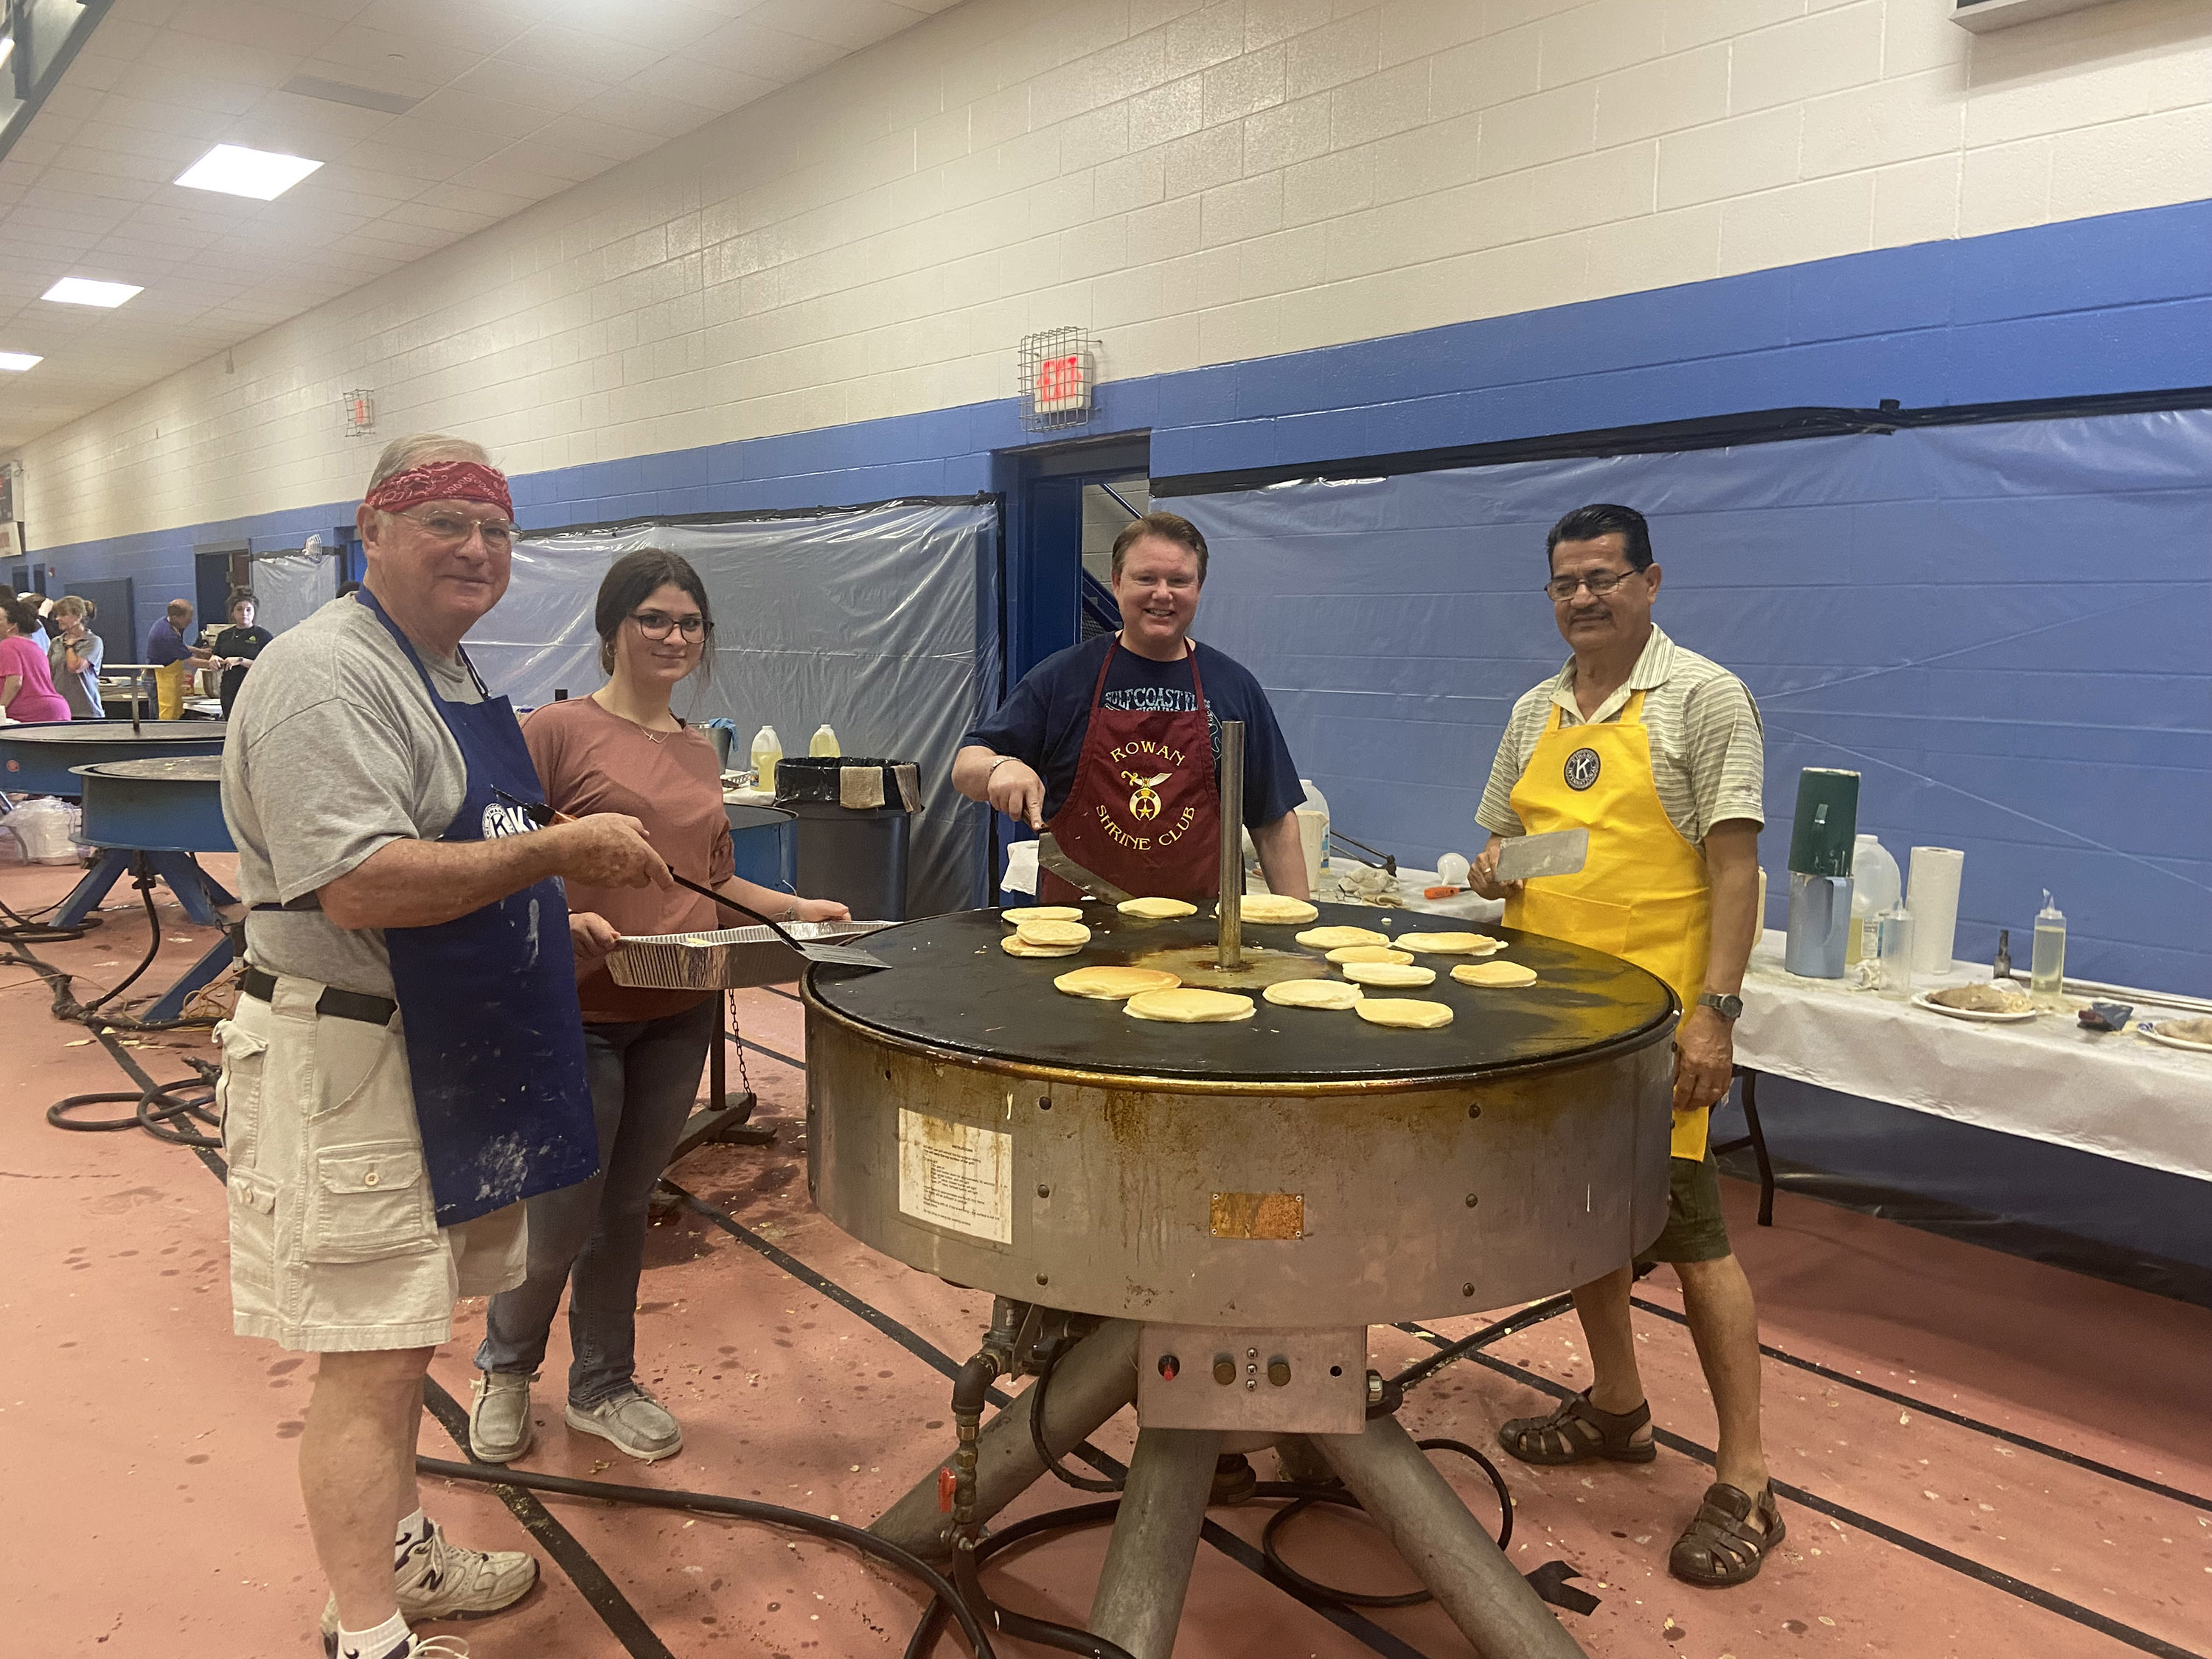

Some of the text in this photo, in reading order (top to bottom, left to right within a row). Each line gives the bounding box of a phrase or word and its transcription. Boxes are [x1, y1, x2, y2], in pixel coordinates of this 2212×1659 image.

[1110, 740, 1186, 766] ROWAN
[1576, 758, 1590, 779] K
[1096, 804, 1195, 850] SHRINE CLUB
